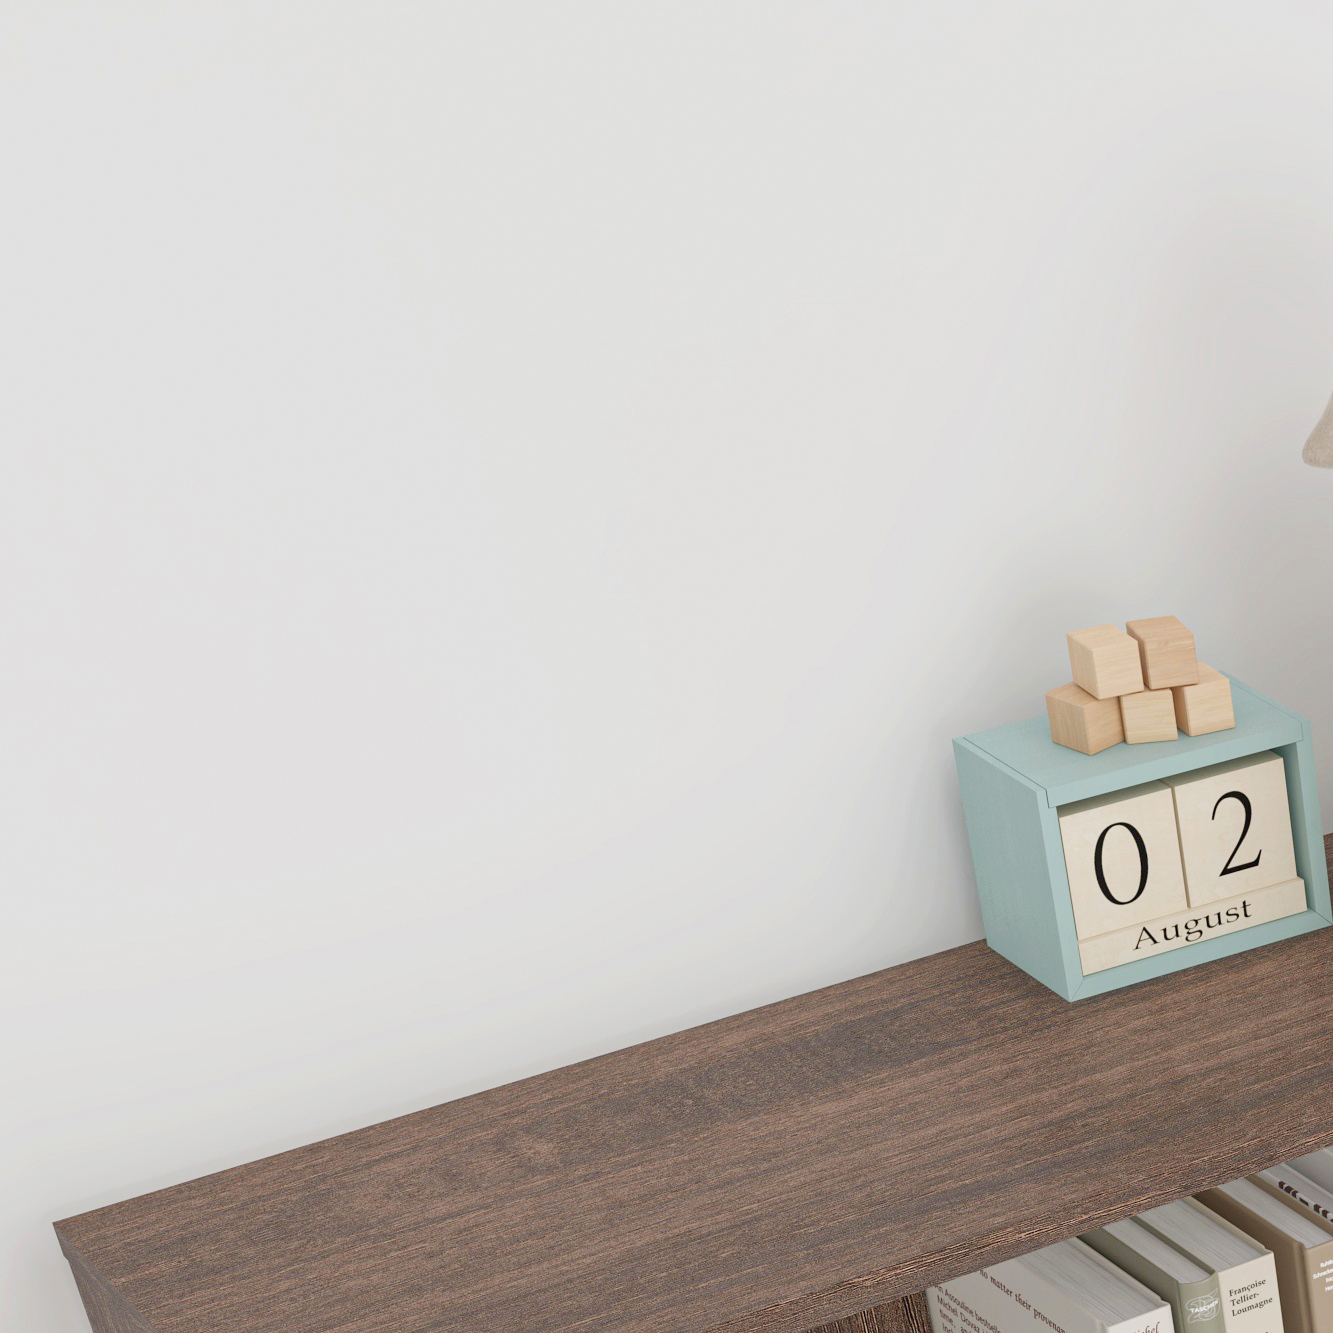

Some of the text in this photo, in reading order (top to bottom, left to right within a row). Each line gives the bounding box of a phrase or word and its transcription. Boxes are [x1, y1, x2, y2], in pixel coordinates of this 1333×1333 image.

[1094, 791, 1262, 905] 0 2
[1134, 900, 1252, 950] August
[1229, 1278, 1266, 1297] Françoise
[1230, 1292, 1259, 1306] Tellier-
[1232, 1297, 1273, 1316] Loumagne
